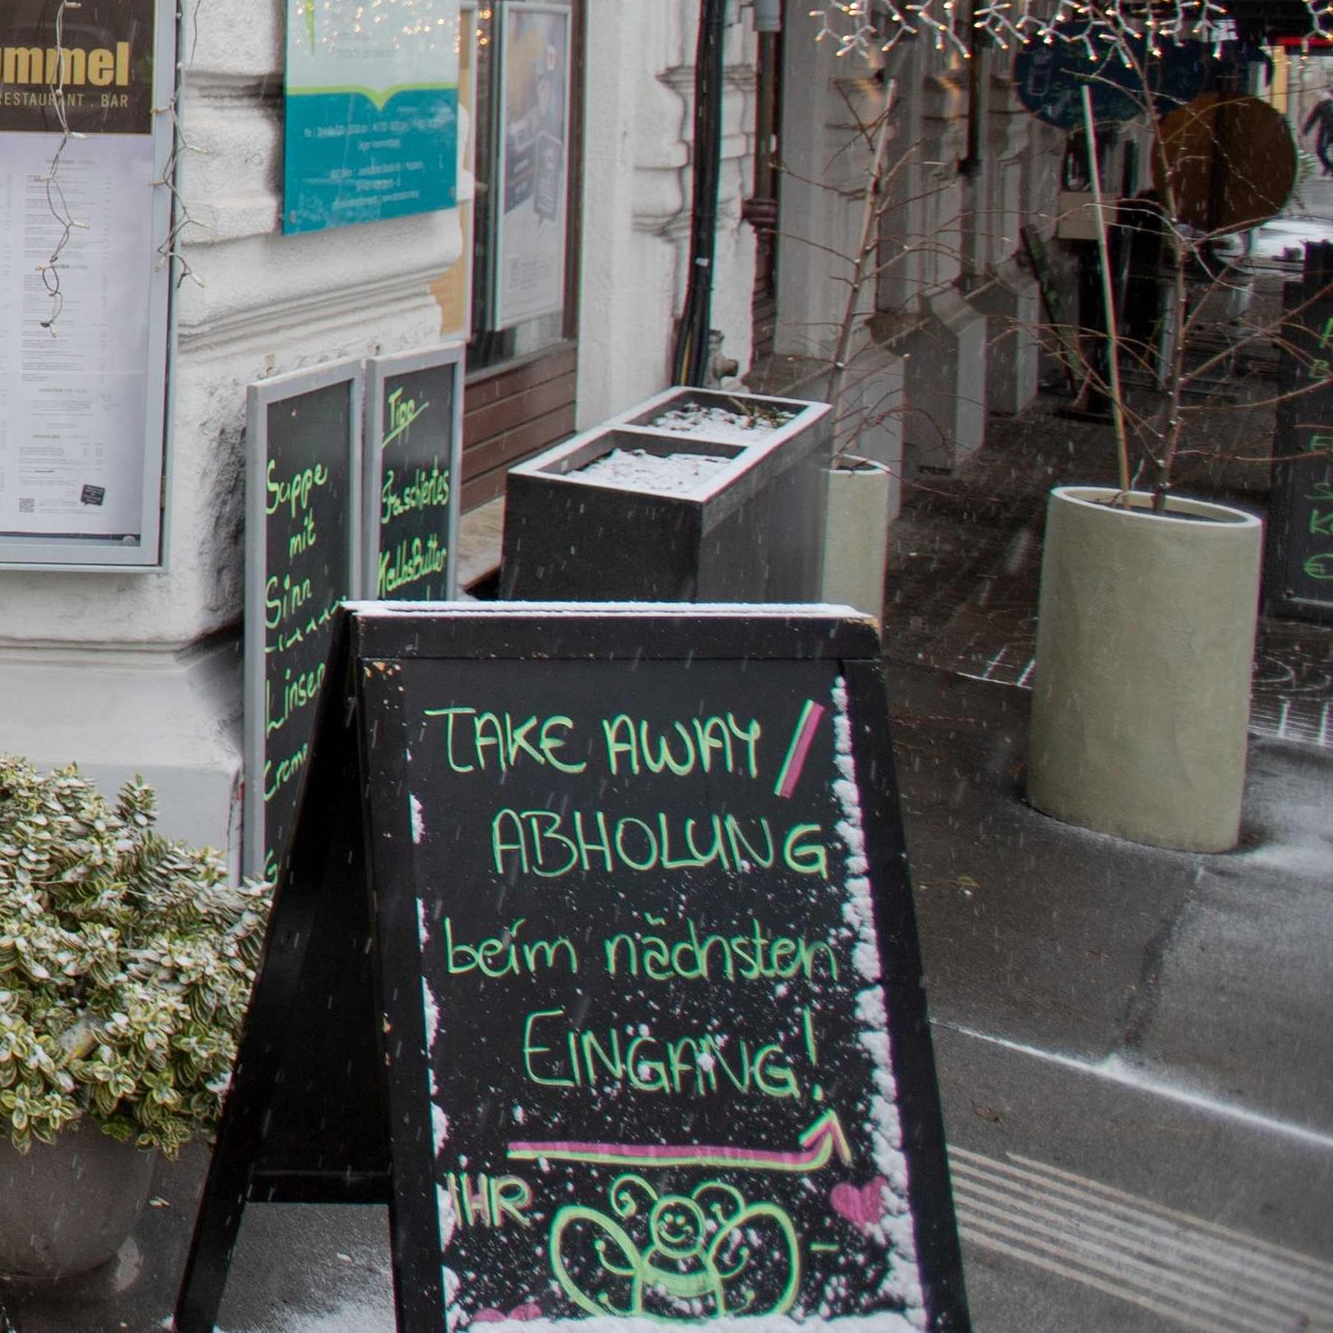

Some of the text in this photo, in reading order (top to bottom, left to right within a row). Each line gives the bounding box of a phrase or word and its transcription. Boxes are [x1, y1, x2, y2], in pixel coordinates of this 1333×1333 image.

[100, 93, 129, 108] BAR
[265, 459, 329, 518] Suppe
[289, 507, 317, 563] mit
[264, 574, 312, 630] Sinn
[425, 707, 586, 773] TAKE
[602, 712, 761, 778] AWAY
[492, 809, 828, 880] ABHOLUNG
[444, 912, 838, 981] beim nächsten
[523, 1006, 825, 1102] EINGANG!
[447, 1172, 533, 1227] IHR
